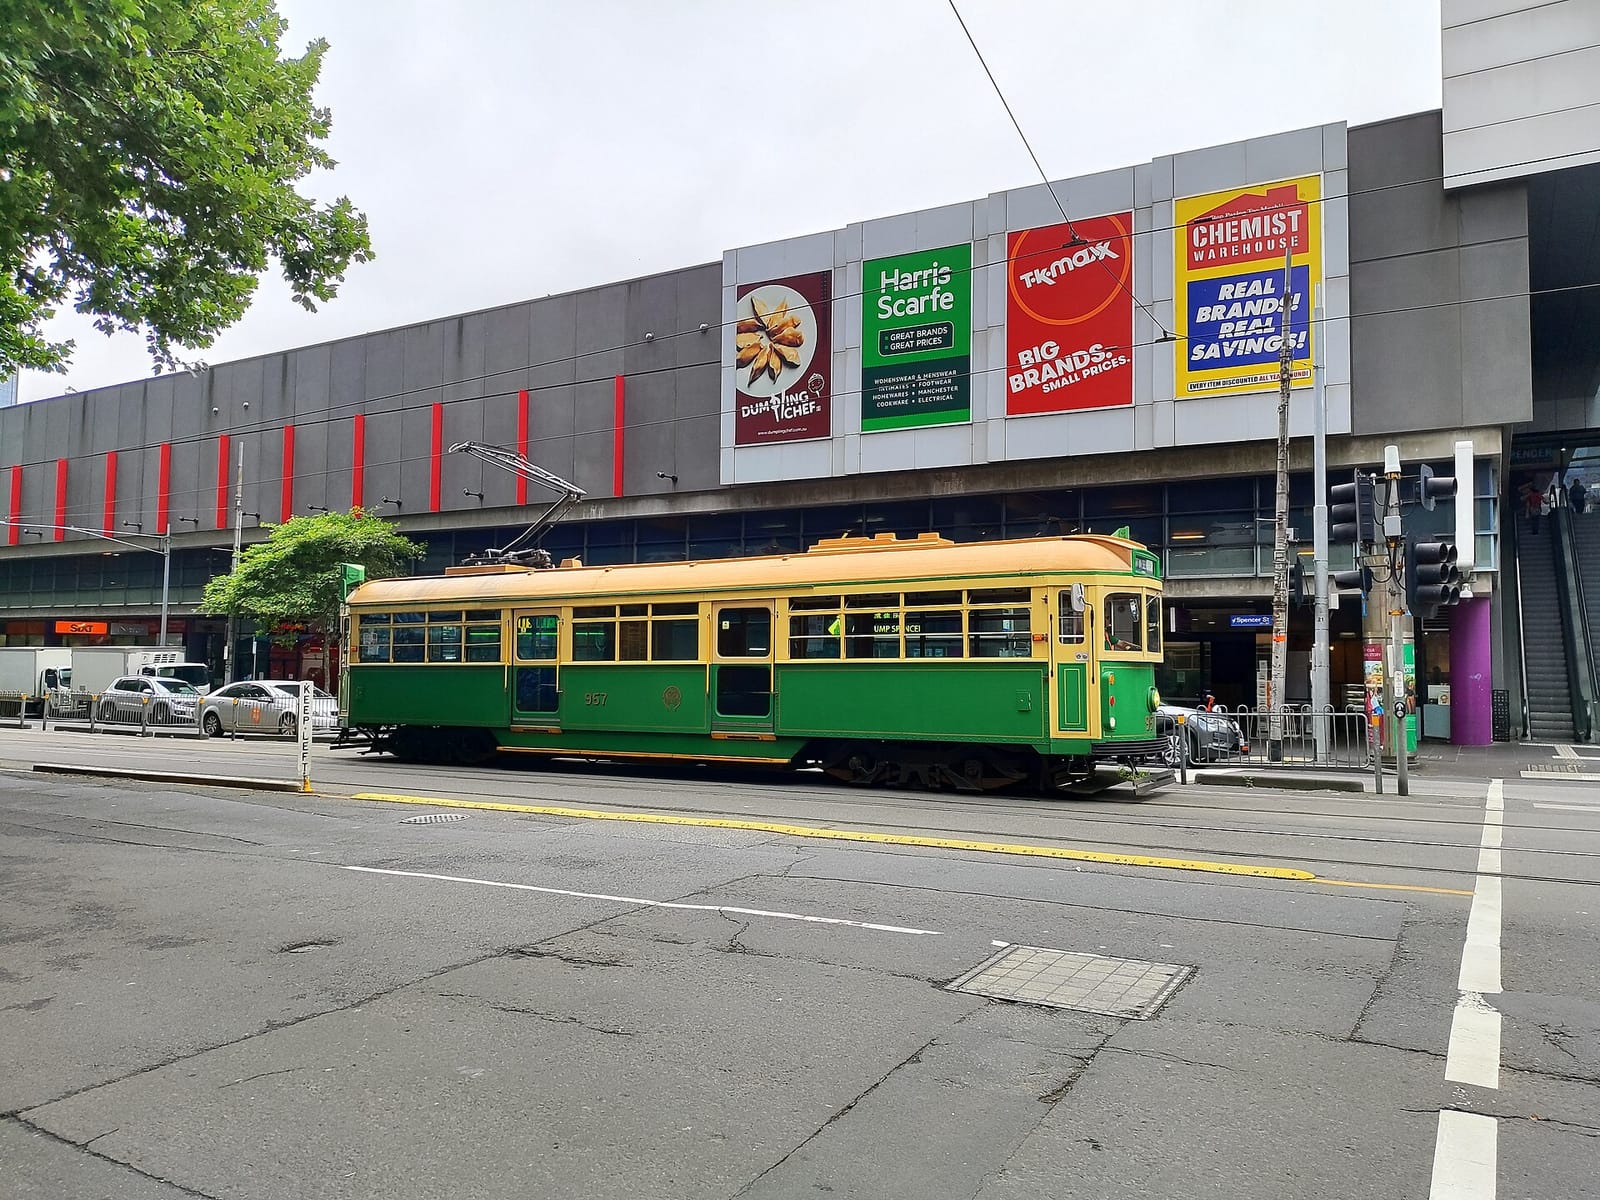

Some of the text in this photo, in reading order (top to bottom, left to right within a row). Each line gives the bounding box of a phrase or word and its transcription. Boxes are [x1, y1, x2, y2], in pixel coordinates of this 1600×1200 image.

[1193, 209, 1302, 248] CHEMIST
[1193, 235, 1298, 261] WAREHOUSE
[880, 261, 952, 294] Harris
[1218, 278, 1275, 300] REAL
[878, 287, 954, 319] Scarfe
[890, 326, 948, 341] GREAT BRANDS
[1218, 317, 1275, 339] REAL
[890, 337, 943, 351] GREAT PRICES
[1018, 340, 1060, 370] BIG
[923, 369, 957, 379] MENSWEAR
[1008, 343, 1113, 394] BRANDS.
[1042, 355, 1131, 394] SMALL PRICES.
[918, 378, 952, 388] FOOTWEAR
[918, 385, 959, 396] MANCHESTER
[1222, 376, 1258, 386] DISCOUNTED
[784, 401, 816, 420] CHEF
[876, 394, 954, 408] COOKWARE ELECTRICAL
[1236, 616, 1261, 625] Spencer
[303, 685, 311, 725] KEEP
[584, 692, 608, 706] 957
